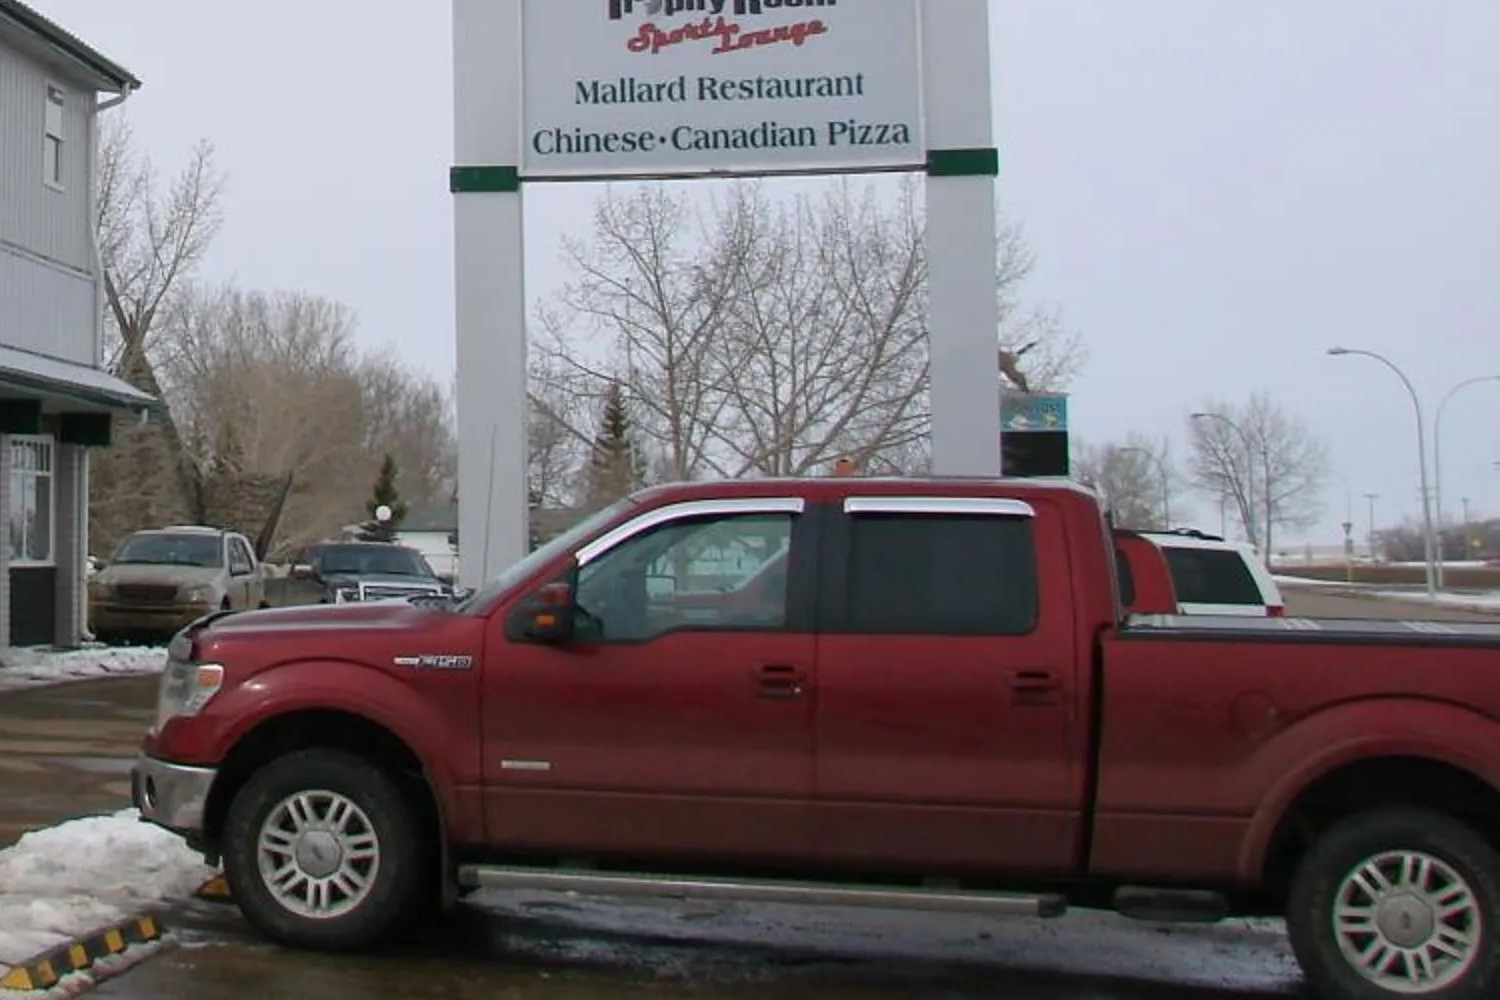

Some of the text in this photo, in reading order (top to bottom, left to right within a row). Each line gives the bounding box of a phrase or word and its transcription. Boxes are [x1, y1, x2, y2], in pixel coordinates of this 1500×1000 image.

[712, 19, 829, 54] Lounge
[575, 72, 864, 105] Mallard Restaurant
[828, 118, 910, 146] Pizza
